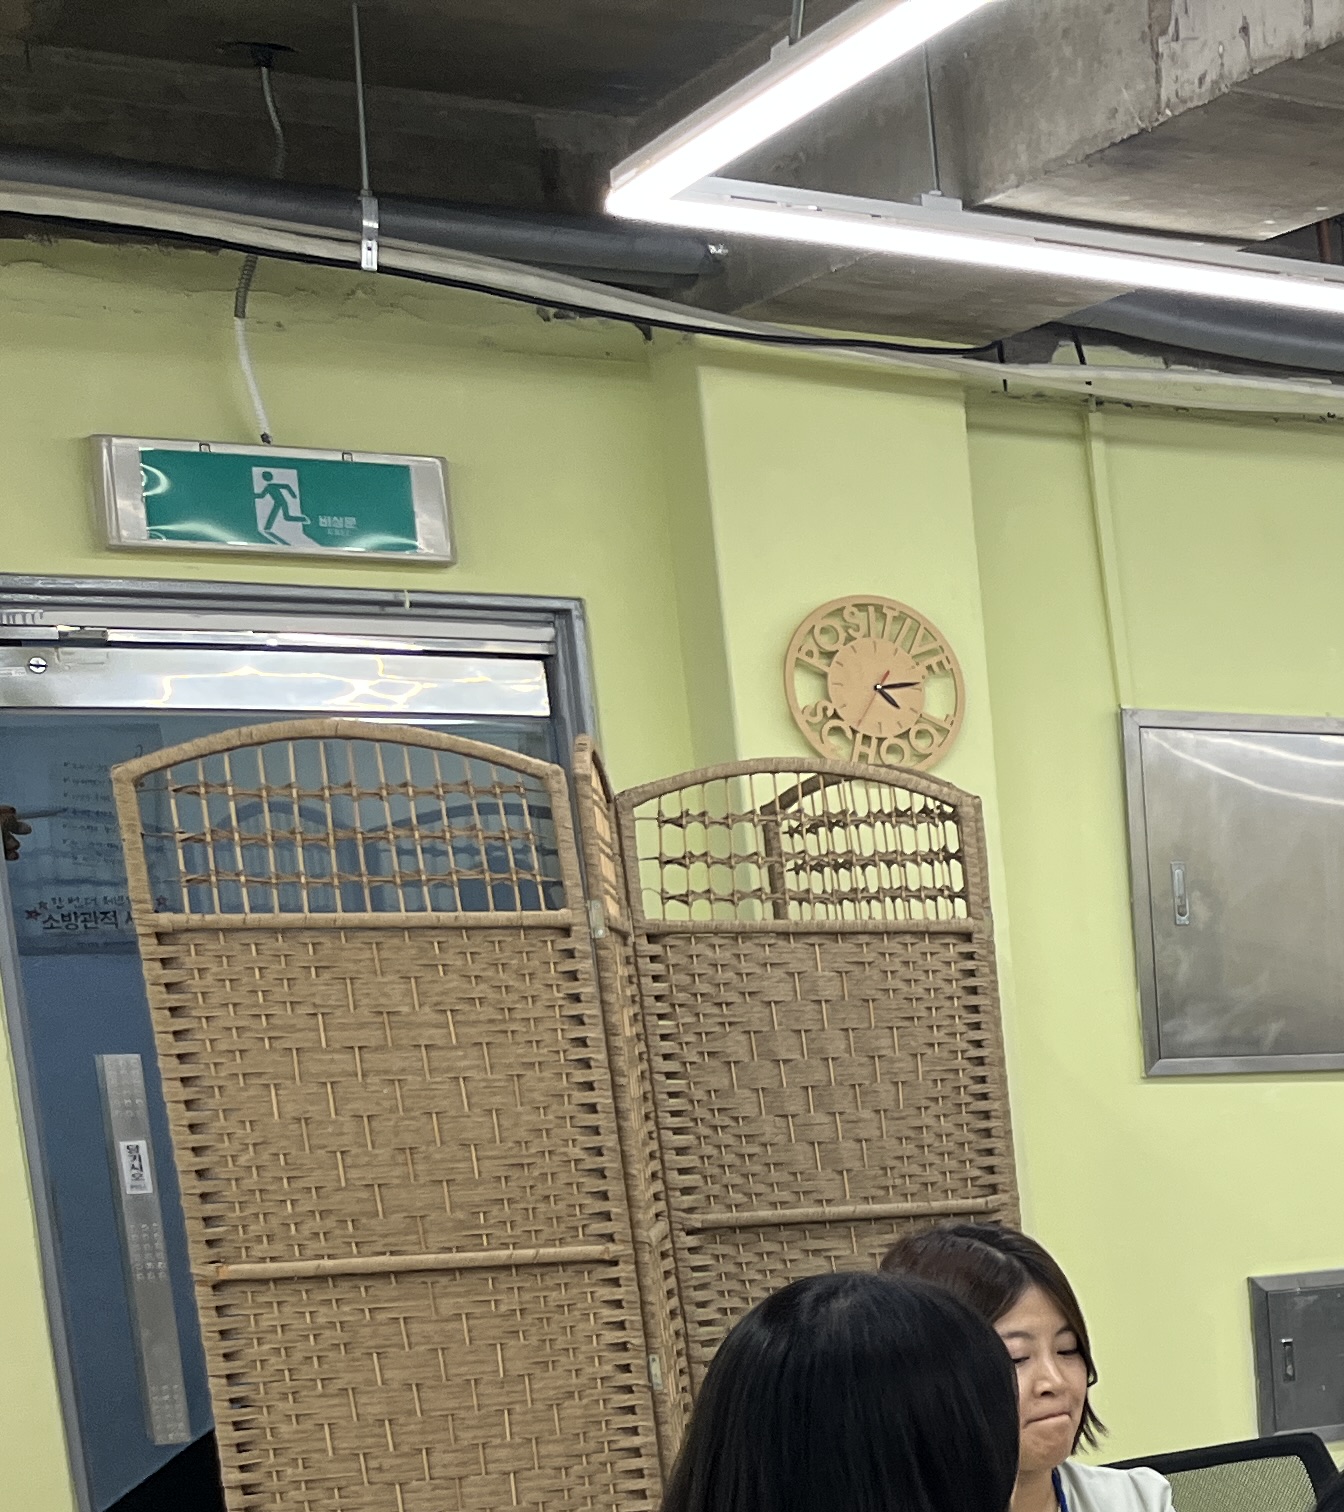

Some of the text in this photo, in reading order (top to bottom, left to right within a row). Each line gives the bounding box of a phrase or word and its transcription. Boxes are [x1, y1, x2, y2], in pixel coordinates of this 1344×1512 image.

[318, 514, 357, 529] 비상문
[797, 605, 953, 678] POSITIVE
[801, 700, 955, 765] SCHOOL
[42, 909, 119, 930] 소방관적
